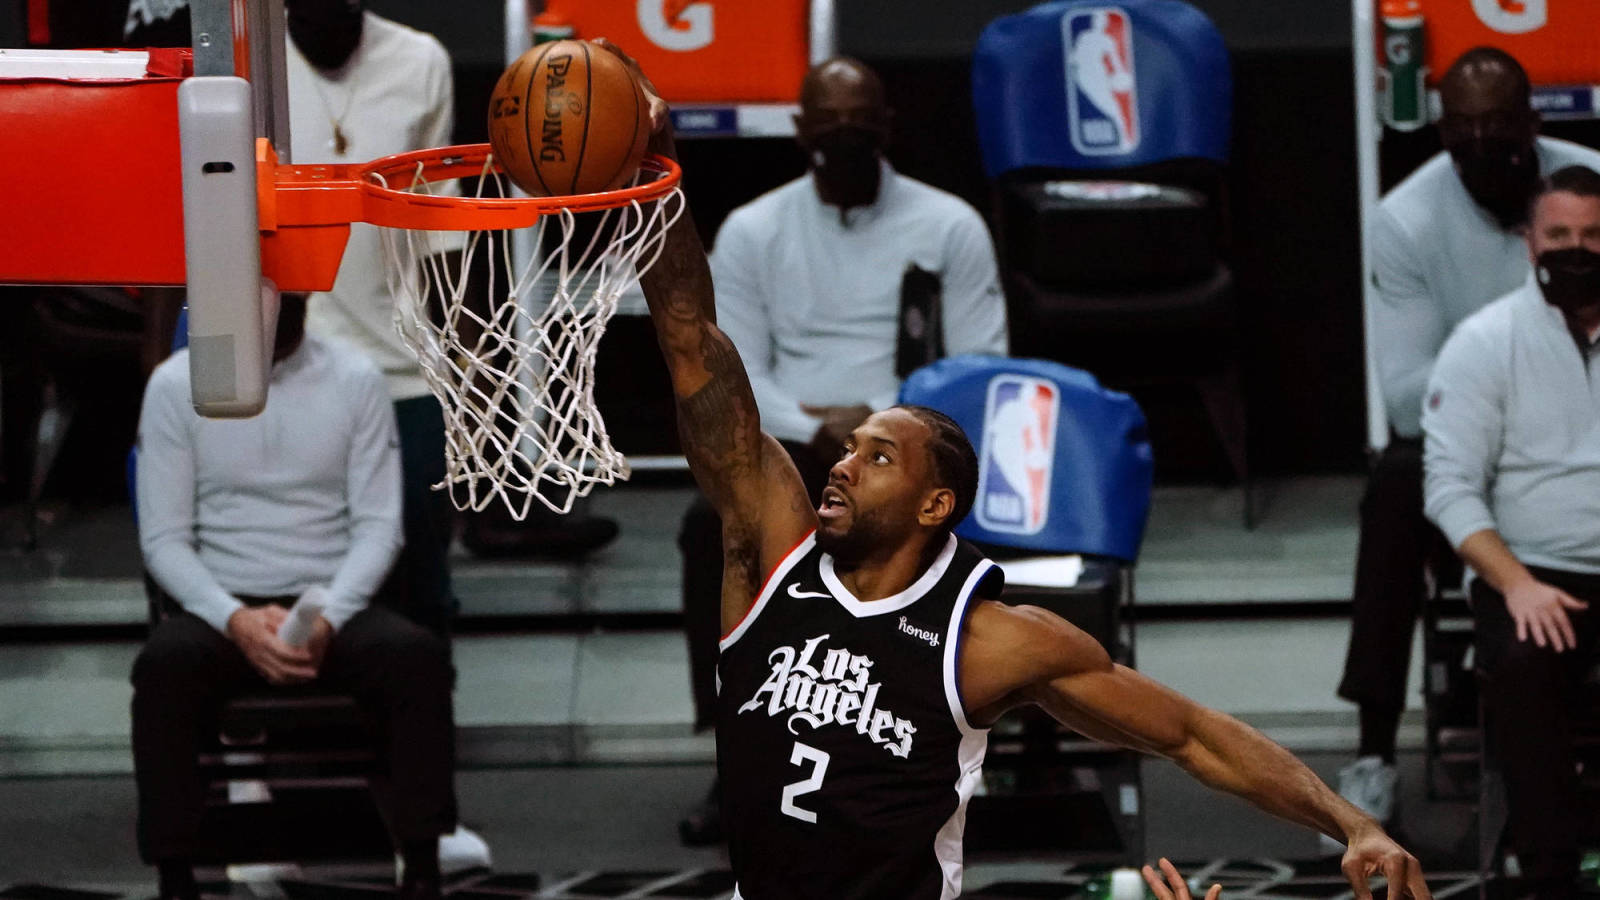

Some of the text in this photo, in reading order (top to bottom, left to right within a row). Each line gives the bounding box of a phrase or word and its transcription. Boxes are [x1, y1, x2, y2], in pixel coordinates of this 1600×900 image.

[790, 634, 874, 692] Los
[899, 615, 940, 647] honey
[738, 645, 917, 759] Angeles
[781, 741, 831, 824] 2
